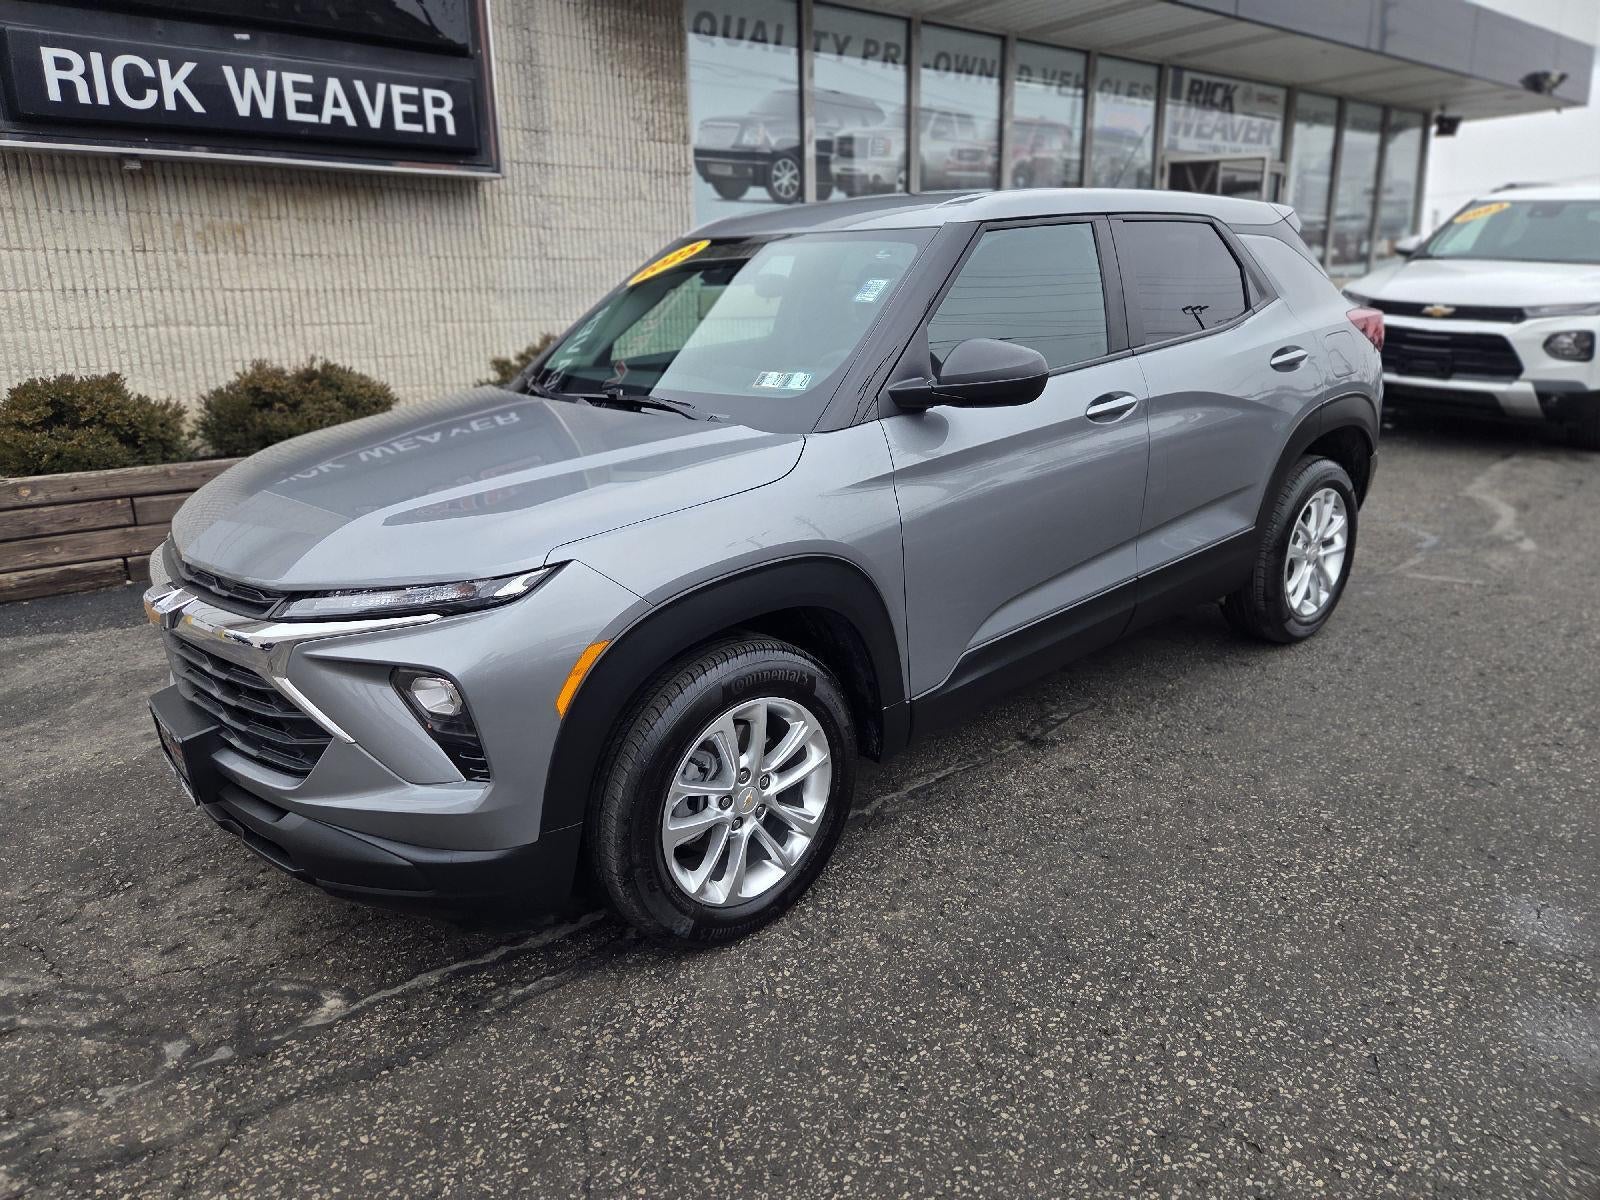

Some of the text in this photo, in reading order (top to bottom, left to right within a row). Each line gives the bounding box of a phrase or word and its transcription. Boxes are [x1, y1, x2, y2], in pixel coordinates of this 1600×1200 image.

[692, 10, 1154, 107] QUALTY PR-OWND VEHCLES
[39, 46, 457, 136] RICK WEAVER
[1186, 79, 1238, 115] RICK
[1170, 108, 1276, 146] WEAVER
